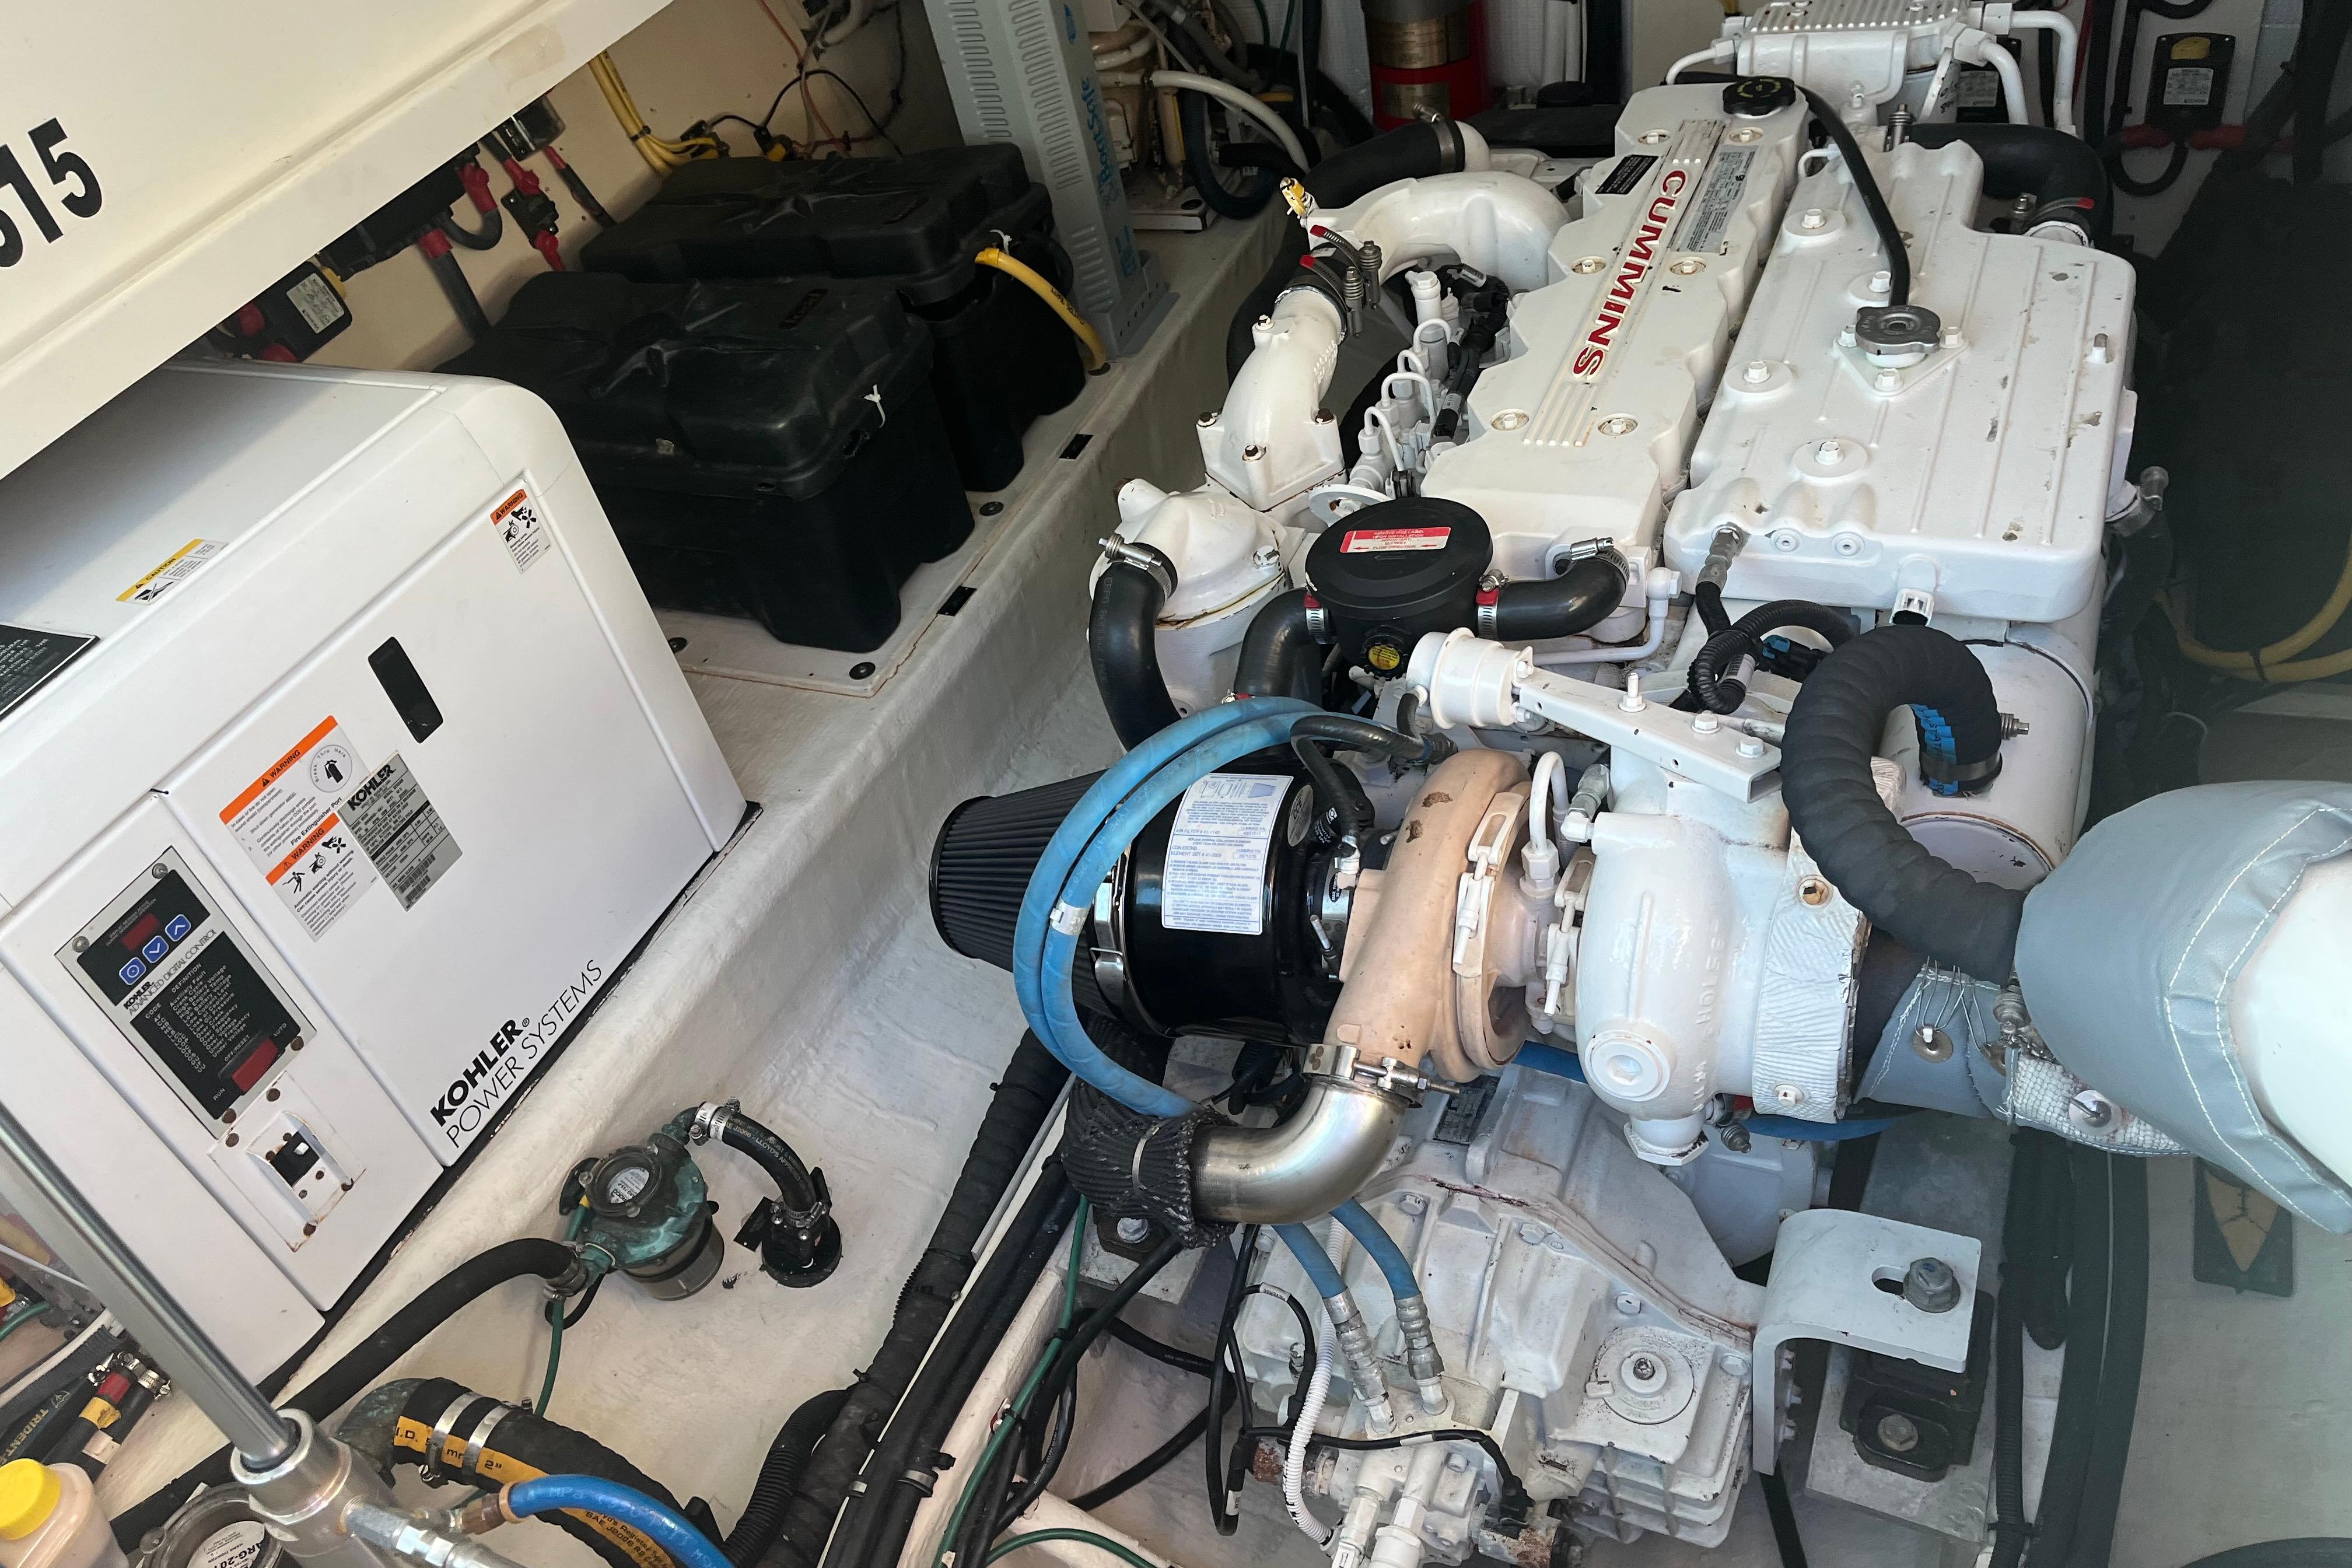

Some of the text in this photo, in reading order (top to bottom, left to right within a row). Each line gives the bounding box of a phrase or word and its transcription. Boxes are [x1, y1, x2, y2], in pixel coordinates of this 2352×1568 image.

[1573, 170, 1687, 380] CUMMINS
[500, 492, 523, 514] WARNING
[145, 556, 177, 581] CAUTION
[269, 748, 301, 779] WARNING
[316, 747, 330, 761] Thru
[347, 762, 394, 811] KOHLER
[290, 796, 342, 845] Fire Extinguisher Port
[291, 828, 325, 860] WARNING
[127, 927, 216, 1016] ADVANCED DIGITAL CONTROL
[123, 979, 153, 1010] KOHLER
[144, 962, 202, 1020] CODE DEFINITION
[153, 1013, 162, 1023] AF
[192, 970, 206, 985] Fault
[172, 994, 188, 1011] Crank
[176, 1001, 190, 1016] High
[188, 982, 208, 1003] Battery
[207, 964, 227, 985] Voltage
[192, 988, 211, 1007] Engine
[209, 974, 225, 989] Temp
[208, 991, 229, 1012] Coolant
[208, 1009, 224, 1026] Crank
[209, 1037, 225, 1054] Under
[225, 1011, 251, 1038] Frequency
[215, 1016, 232, 1034] Speed
[212, 1041, 228, 1058] Under
[446, 960, 601, 1148] POWER SYSTEMS
[212, 1087, 225, 1101] RUN
[734, 1126, 751, 1138] J2006
[755, 1138, 779, 1157] LLOYD'S
